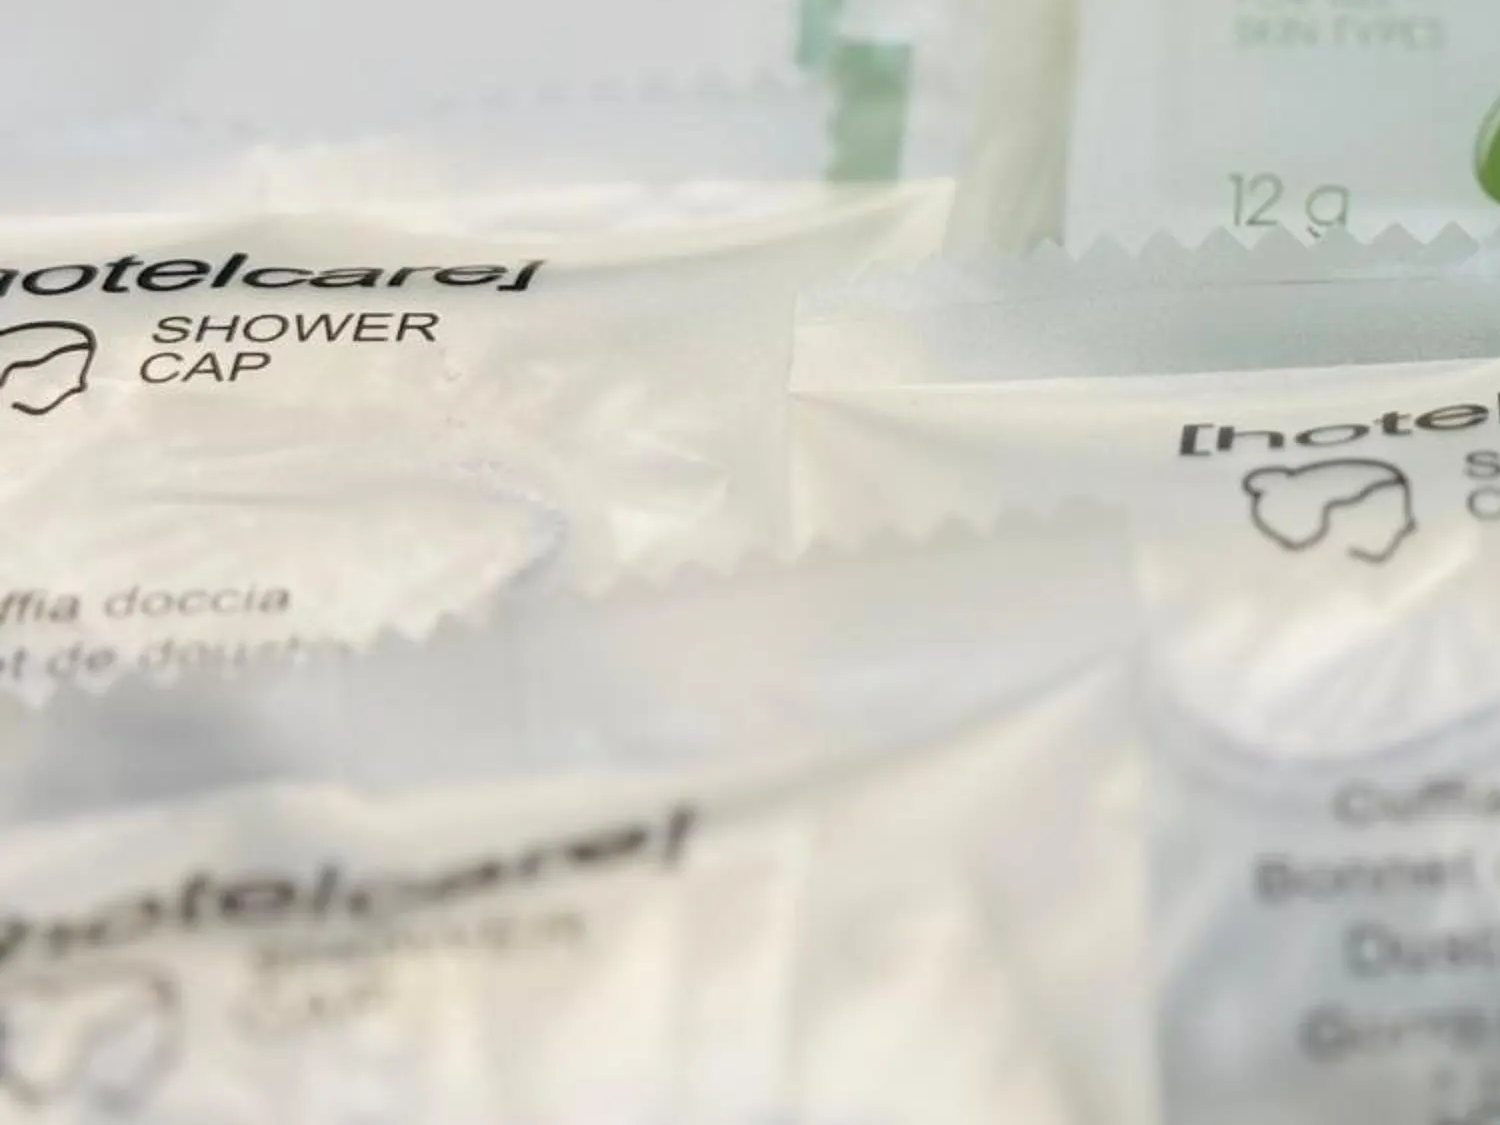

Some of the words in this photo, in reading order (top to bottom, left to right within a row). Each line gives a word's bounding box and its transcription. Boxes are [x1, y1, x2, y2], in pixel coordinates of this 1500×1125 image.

[1228, 172, 1284, 228] 12
[152, 312, 440, 343] SHOWER
[139, 351, 272, 383] CAP
[104, 583, 292, 620] doccia
